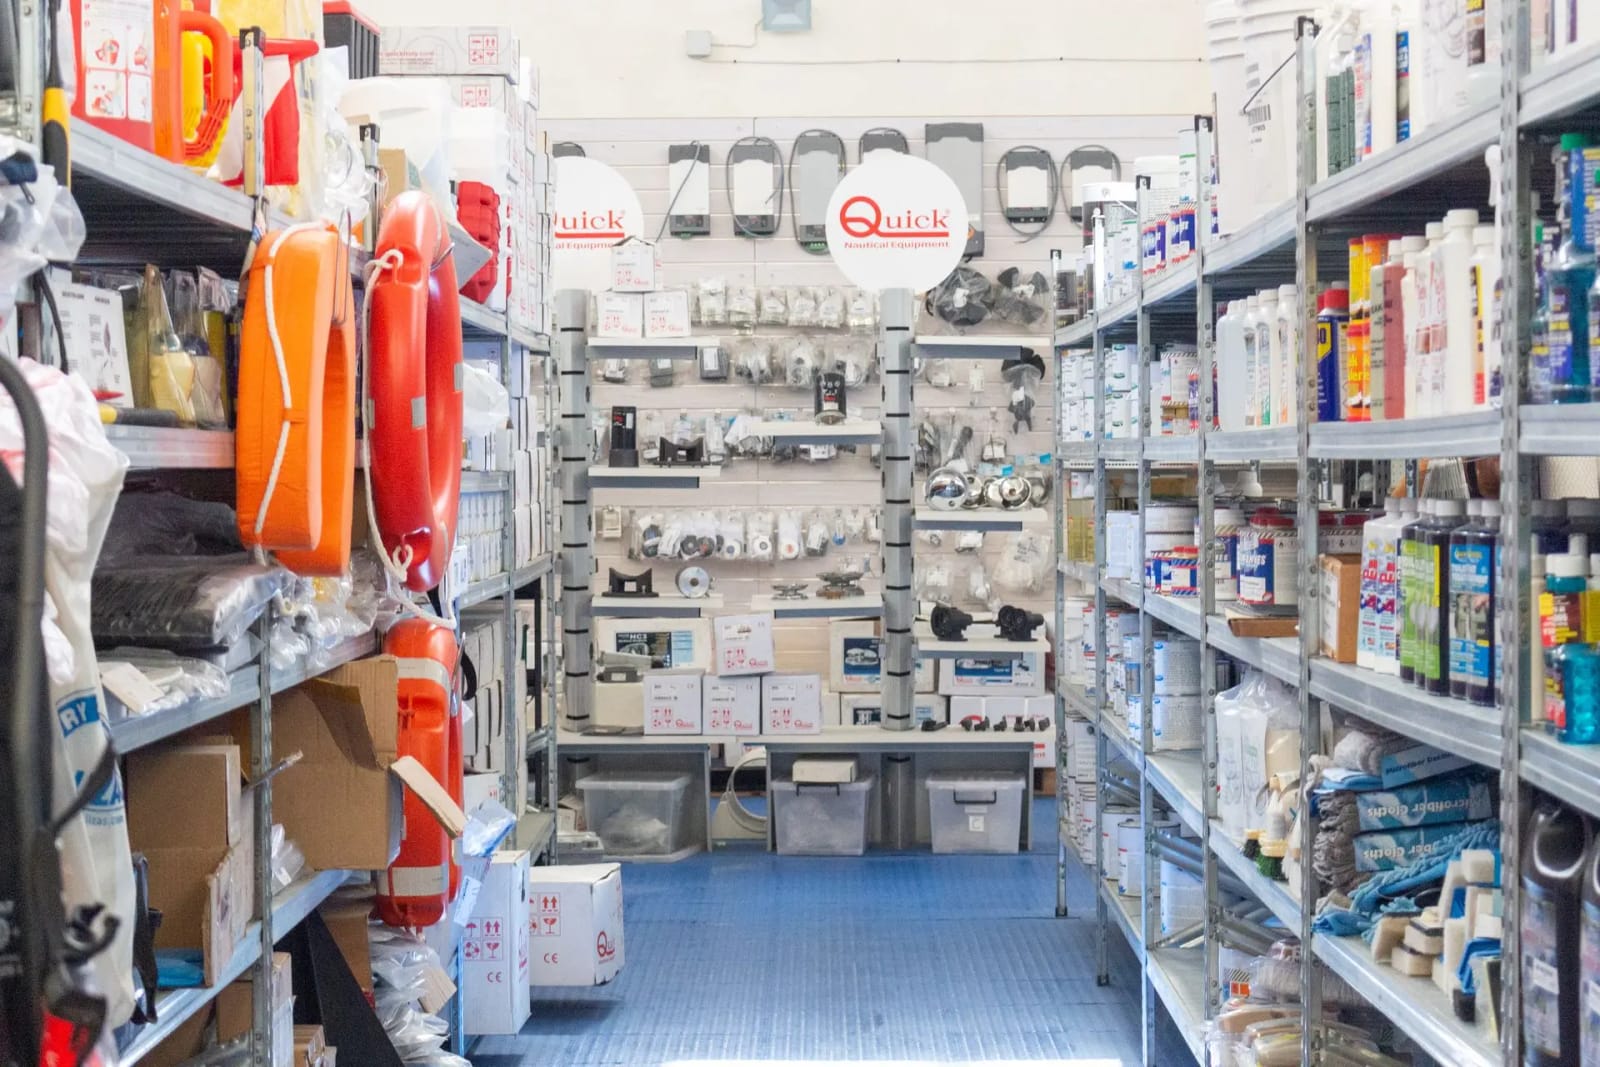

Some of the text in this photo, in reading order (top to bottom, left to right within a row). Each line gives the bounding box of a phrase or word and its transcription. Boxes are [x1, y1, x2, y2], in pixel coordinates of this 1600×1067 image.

[839, 195, 950, 238] Quick
[554, 209, 625, 238] uick
[843, 240, 950, 250] Nautical Equipment
[1367, 805, 1409, 817] Cloths
[1363, 847, 1405, 859] Cloths
